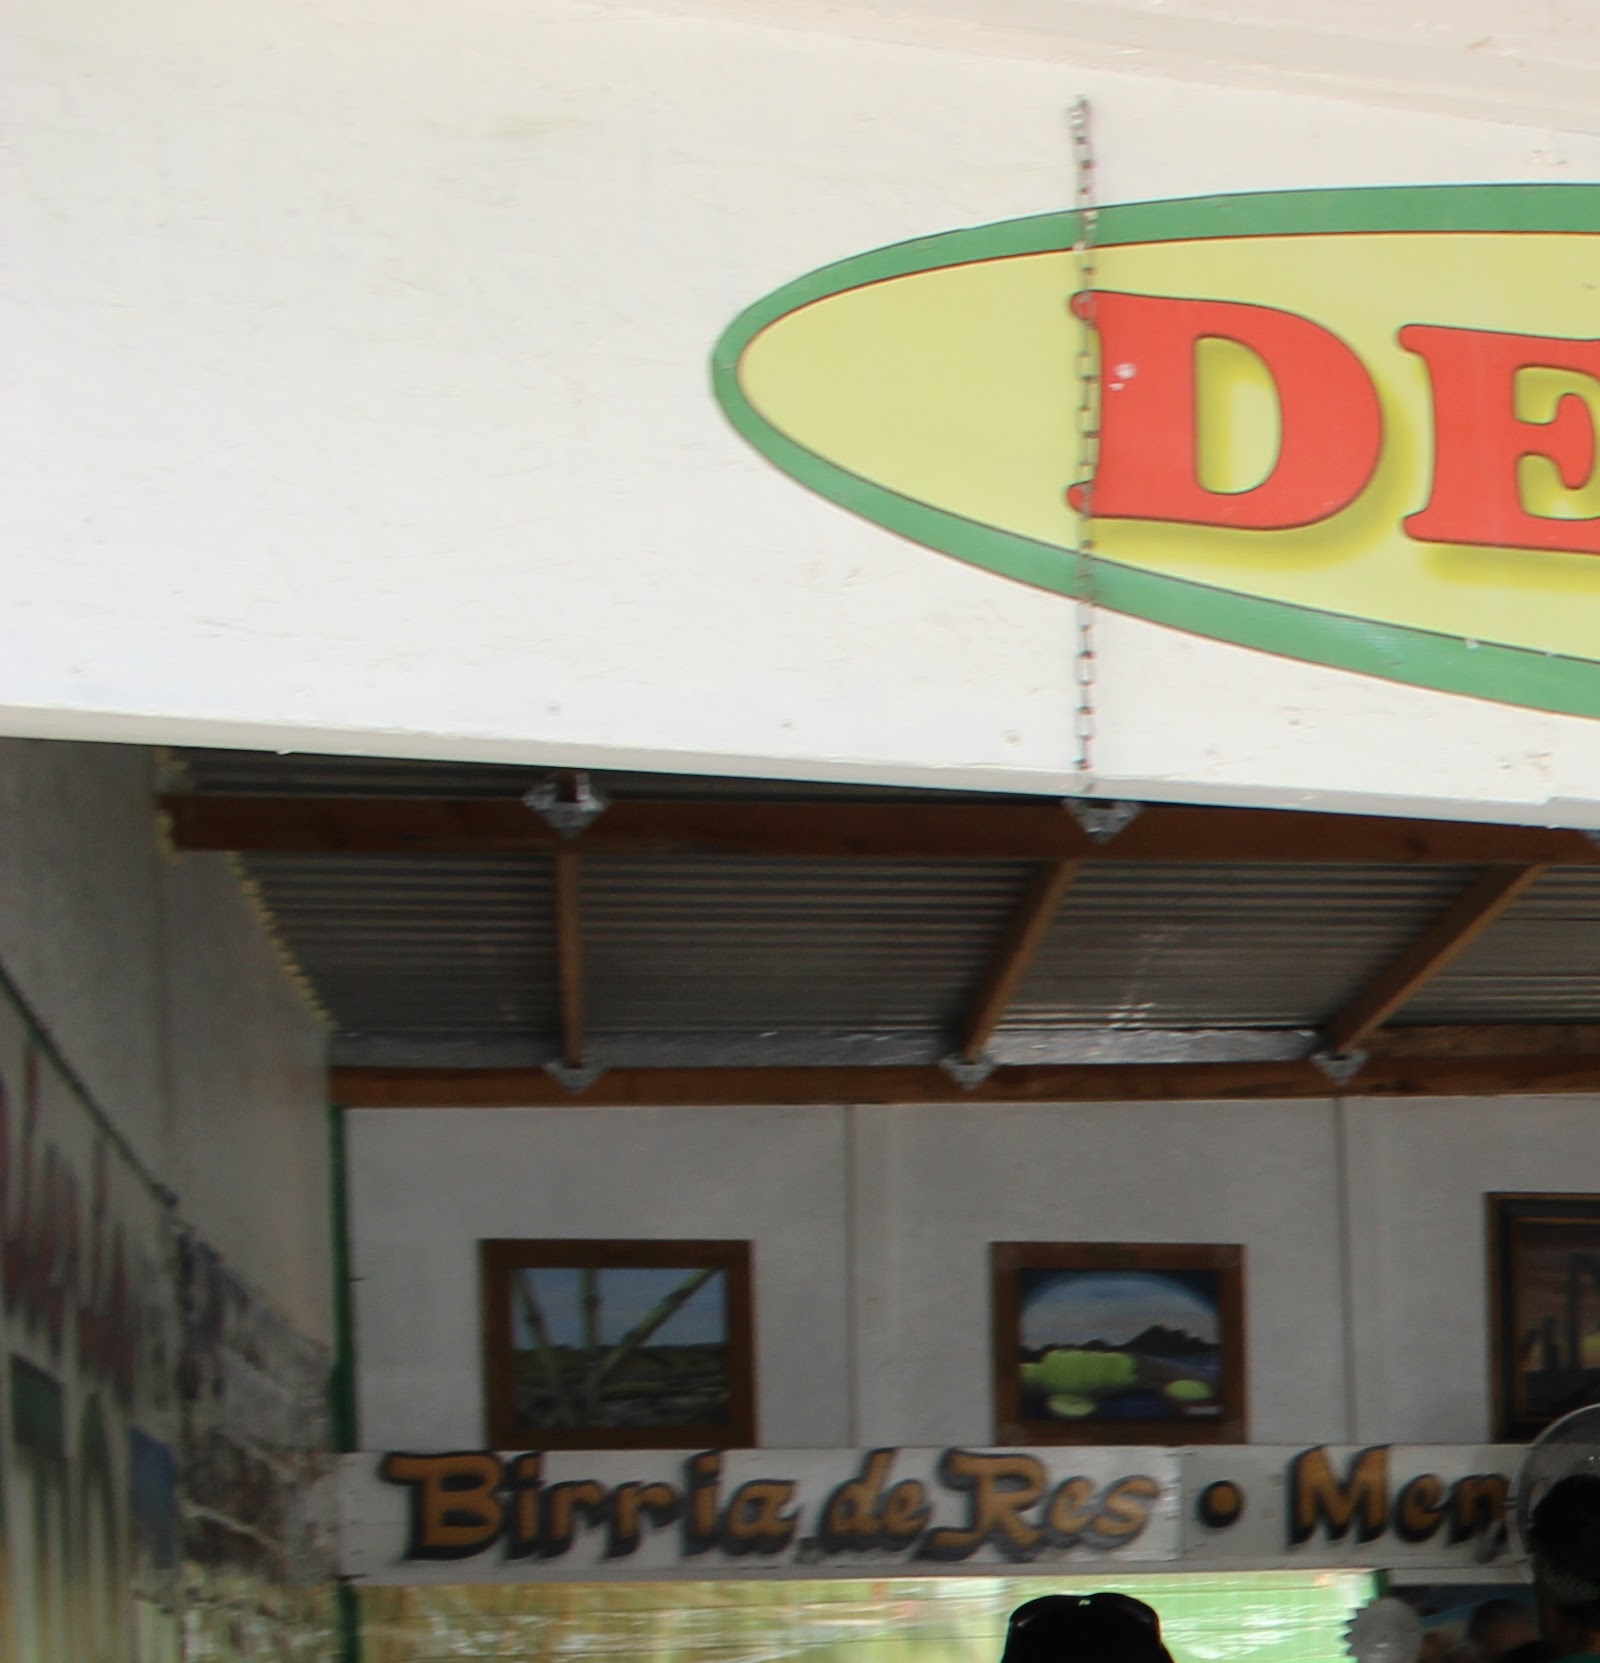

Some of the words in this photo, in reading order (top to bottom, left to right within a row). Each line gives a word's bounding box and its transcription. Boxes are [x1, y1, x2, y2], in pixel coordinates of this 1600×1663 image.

[383, 1448, 798, 1561] Birria
[815, 1447, 932, 1555] de
[912, 1447, 1162, 1560] Res
